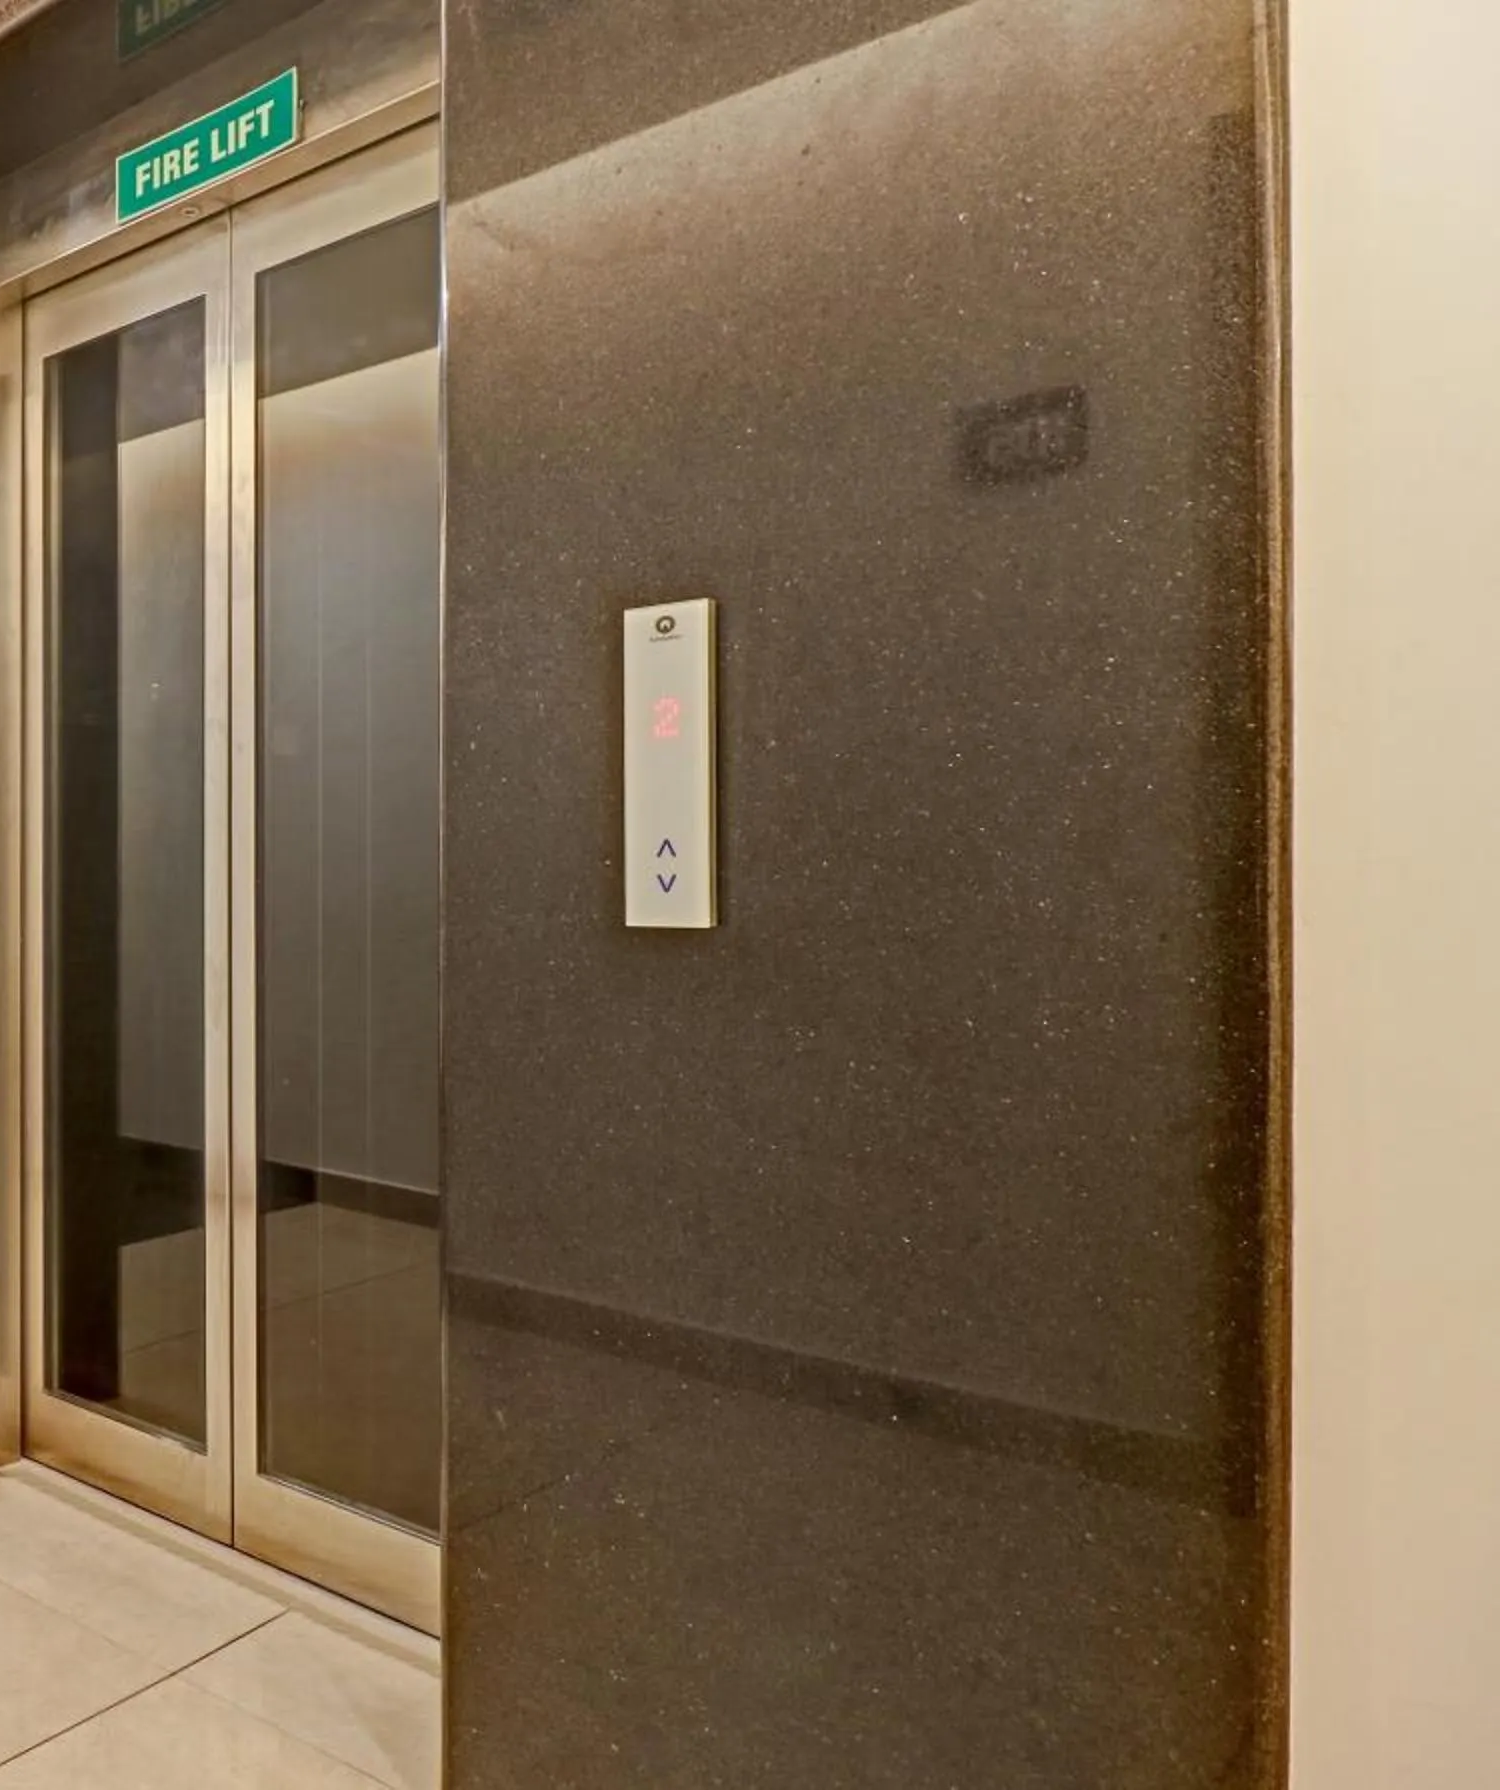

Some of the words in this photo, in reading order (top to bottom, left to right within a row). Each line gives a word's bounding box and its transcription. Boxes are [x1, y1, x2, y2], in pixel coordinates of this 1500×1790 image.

[135, 138, 200, 198] FIRE
[210, 99, 275, 163] LIFT
[652, 696, 680, 738] 2
